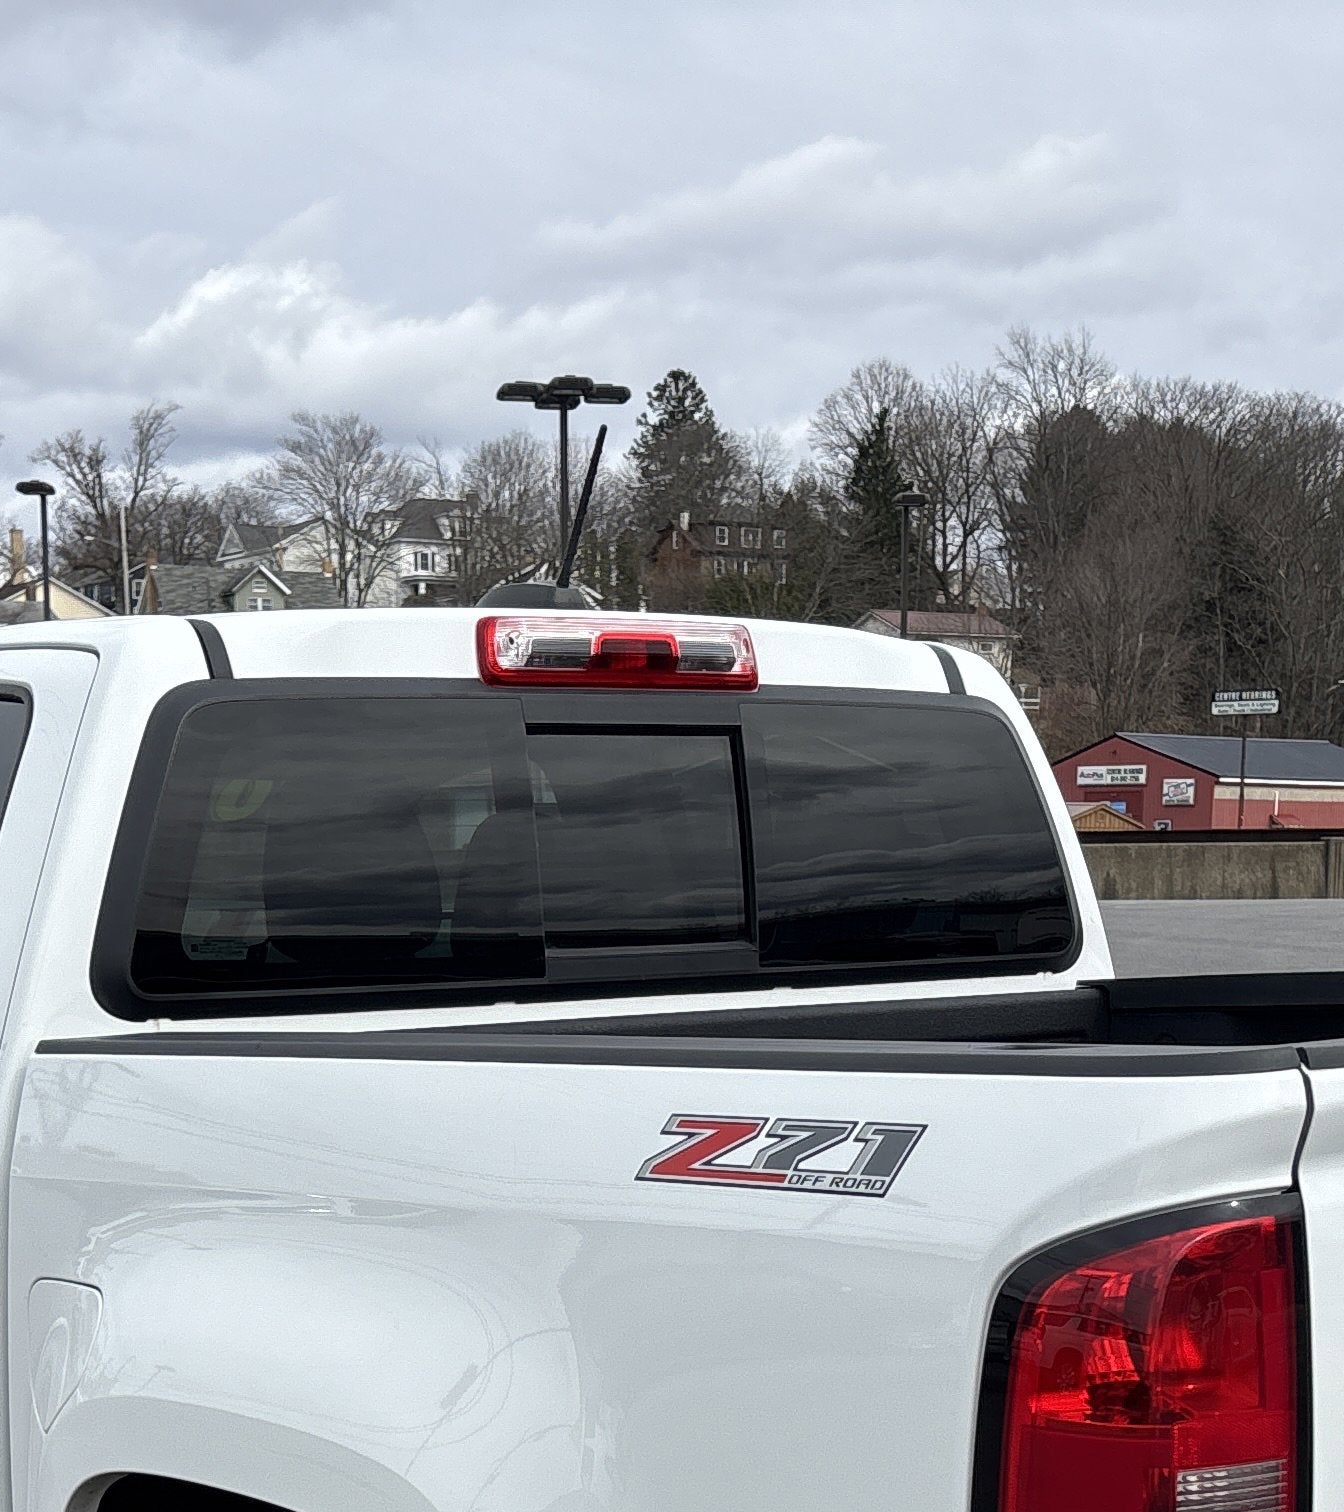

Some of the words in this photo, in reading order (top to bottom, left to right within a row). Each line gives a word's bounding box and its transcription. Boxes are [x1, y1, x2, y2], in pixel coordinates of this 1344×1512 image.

[634, 1113, 928, 1195] Z71
[787, 1173, 827, 1187] OFF
[829, 1175, 886, 1191] ROAD
